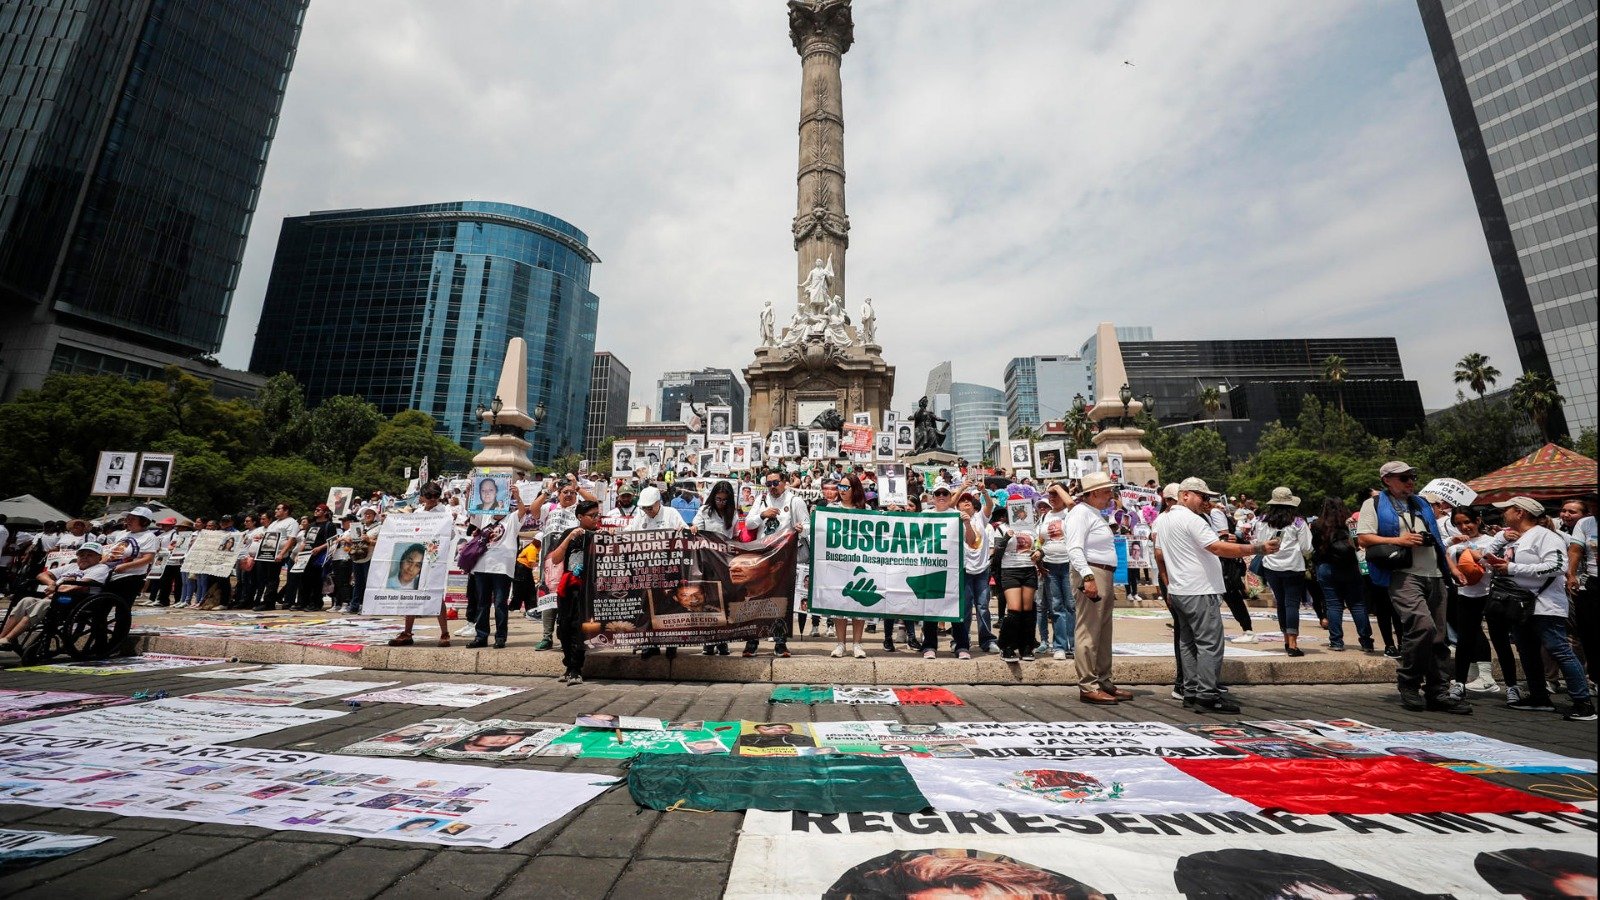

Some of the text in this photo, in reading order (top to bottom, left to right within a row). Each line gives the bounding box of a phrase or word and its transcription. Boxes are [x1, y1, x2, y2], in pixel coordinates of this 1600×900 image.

[594, 530, 688, 544] PRESIDENTA:
[826, 518, 947, 554] BUSCAME
[595, 544, 614, 554] DE
[619, 541, 670, 552] MADRE
[675, 540, 683, 549] A
[596, 554, 625, 563] ¿QUÉ
[629, 551, 668, 561] HARÍAS
[826, 551, 947, 567] Buscando Desaparecidos México
[597, 560, 645, 570] NUESTRO
[648, 559, 680, 567] LUGAR
[597, 569, 632, 577] FUERA
[663, 617, 718, 625] DESAPARECIDO
[1029, 730, 1137, 738] GRANDE
[1032, 738, 1142, 746] JALISCO
[793, 809, 1337, 835] REGRESENME
[1328, 812, 1410, 835] A
